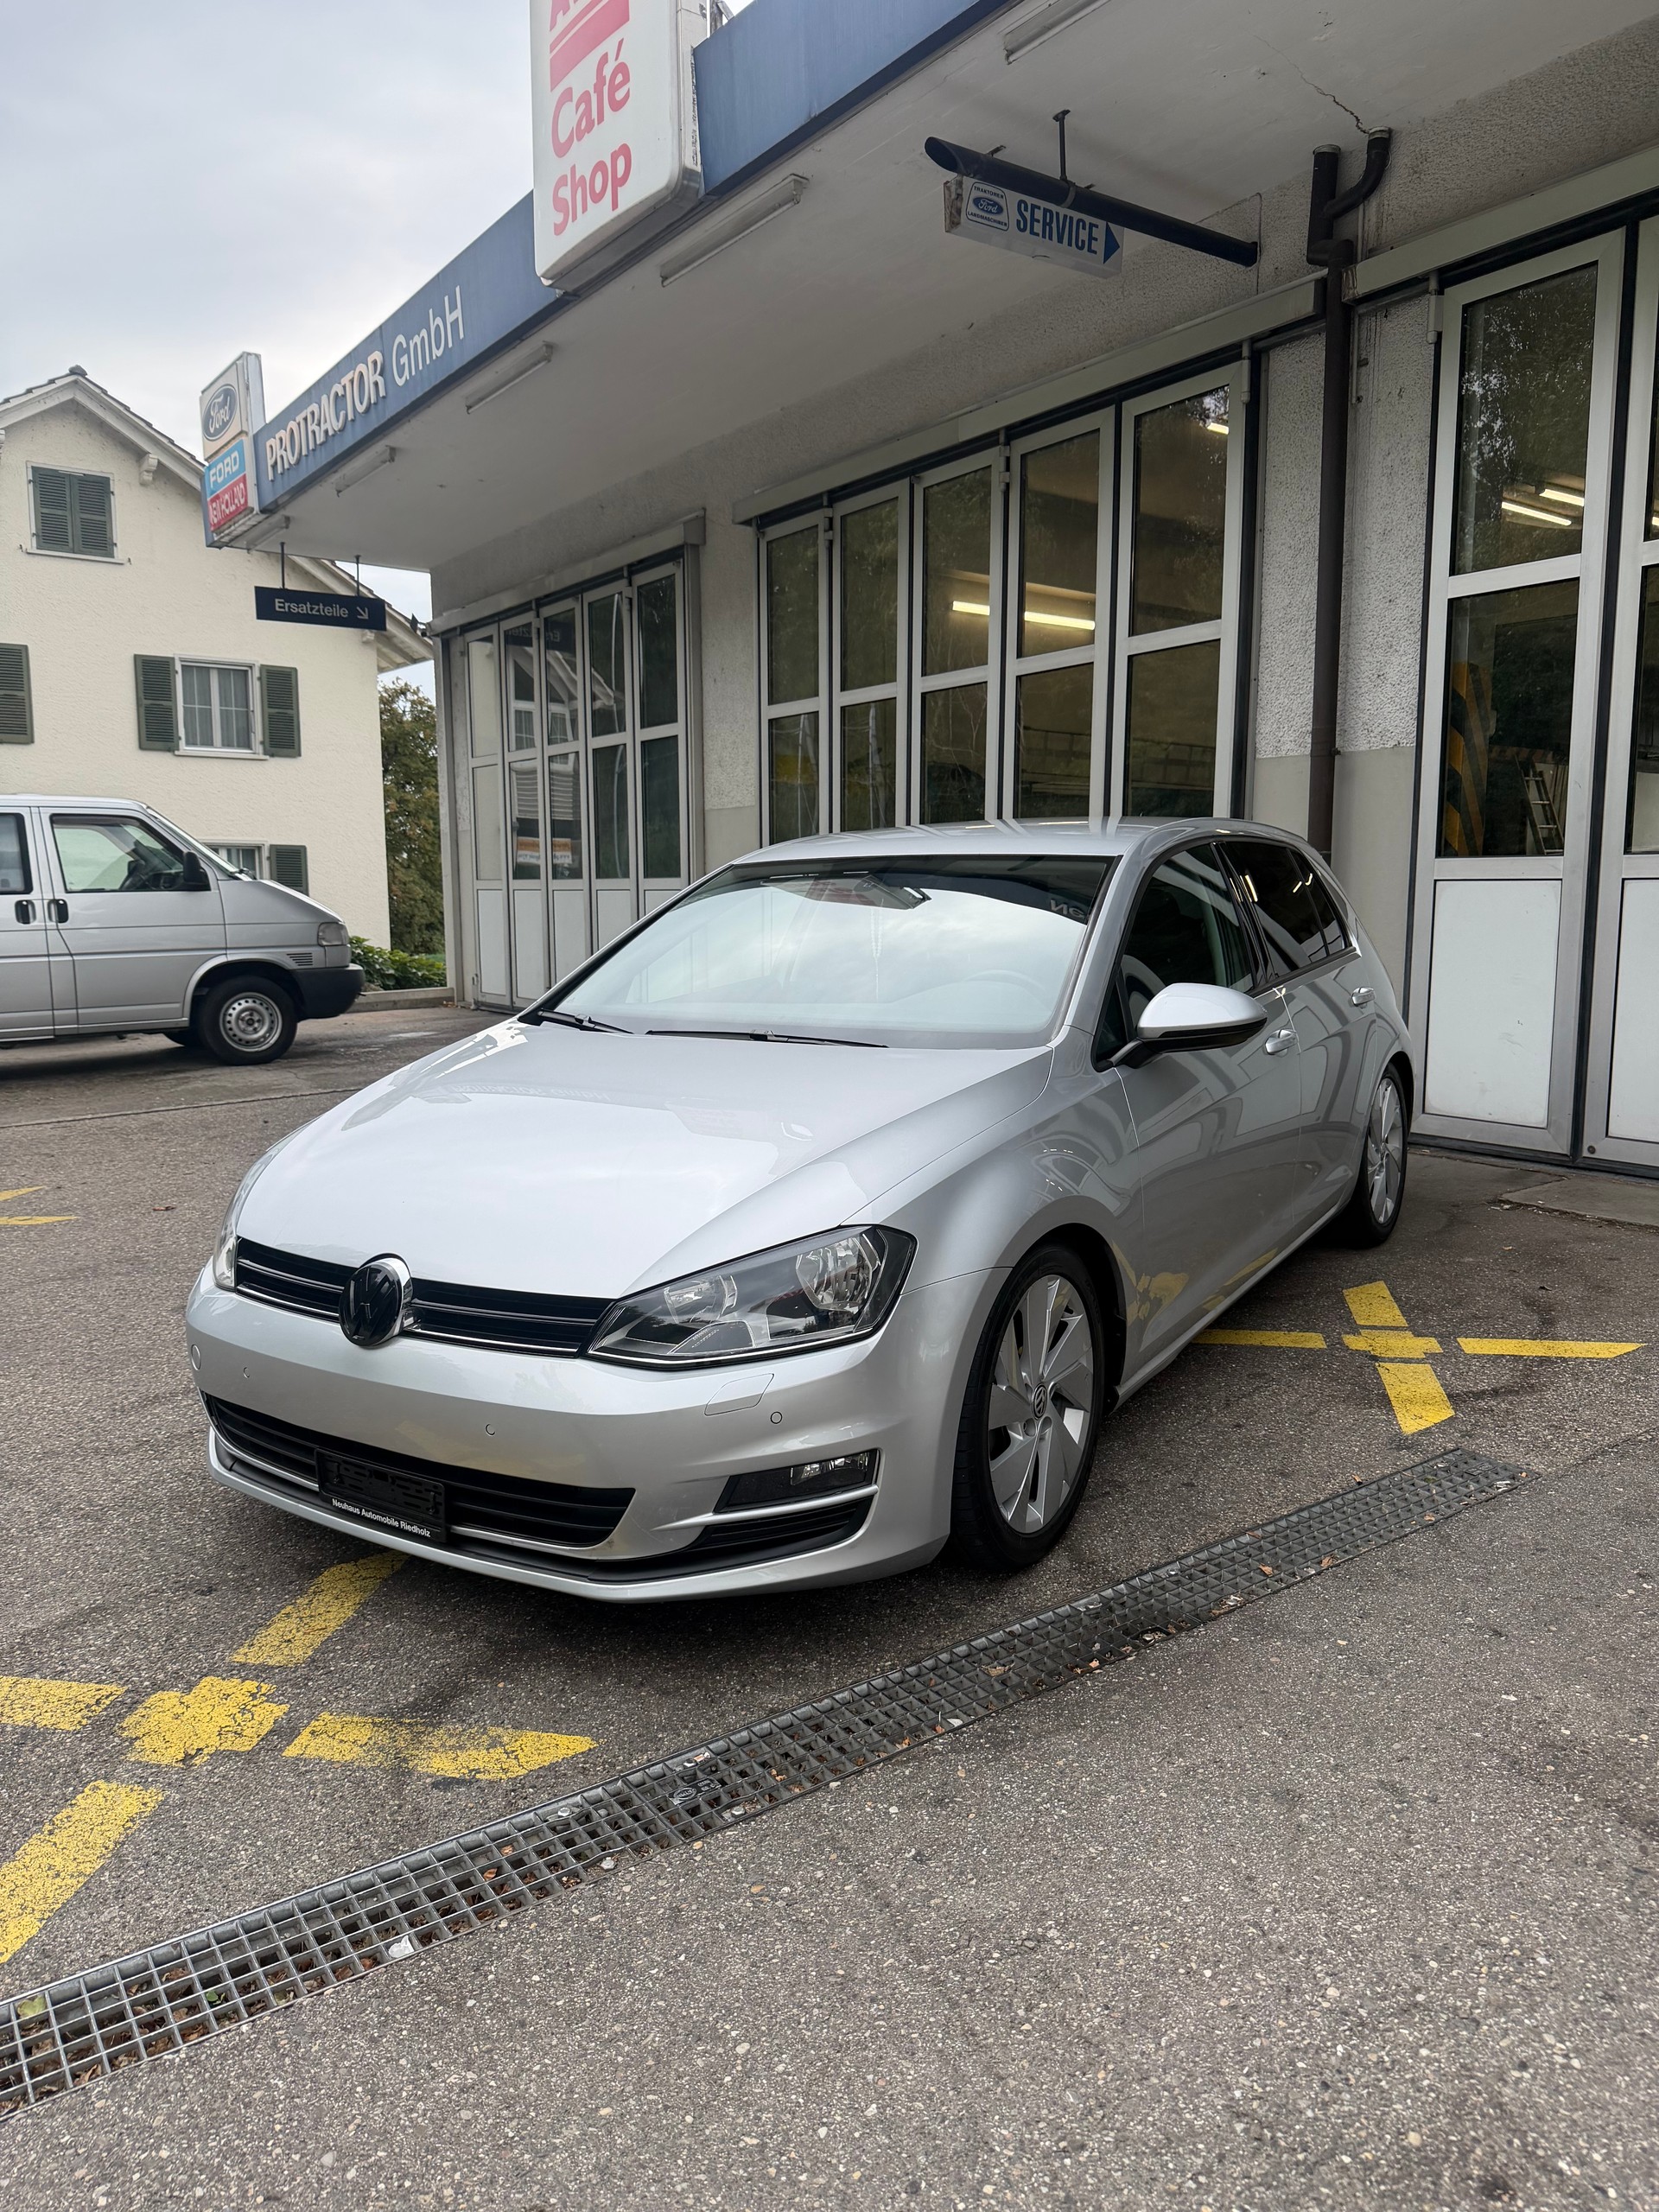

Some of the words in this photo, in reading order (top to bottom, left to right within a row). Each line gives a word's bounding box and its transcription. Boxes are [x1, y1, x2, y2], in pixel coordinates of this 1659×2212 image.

[551, 38, 631, 159] Café
[552, 143, 632, 236] Shop
[973, 185, 1004, 200] TRAKTOREN
[978, 199, 998, 213] Ford
[1016, 199, 1099, 255] SERVICE
[265, 350, 386, 481] PROTRACTOR
[392, 285, 465, 386] GmbH
[209, 394, 231, 434] Ford
[210, 450, 239, 489] FORD
[220, 482, 245, 518] HOLLAND
[275, 598, 349, 618] Ersatzteile
[332, 1498, 360, 1515] Neuhaus
[361, 1509, 399, 1528] Automobile
[400, 1521, 431, 1538] Riedholz
